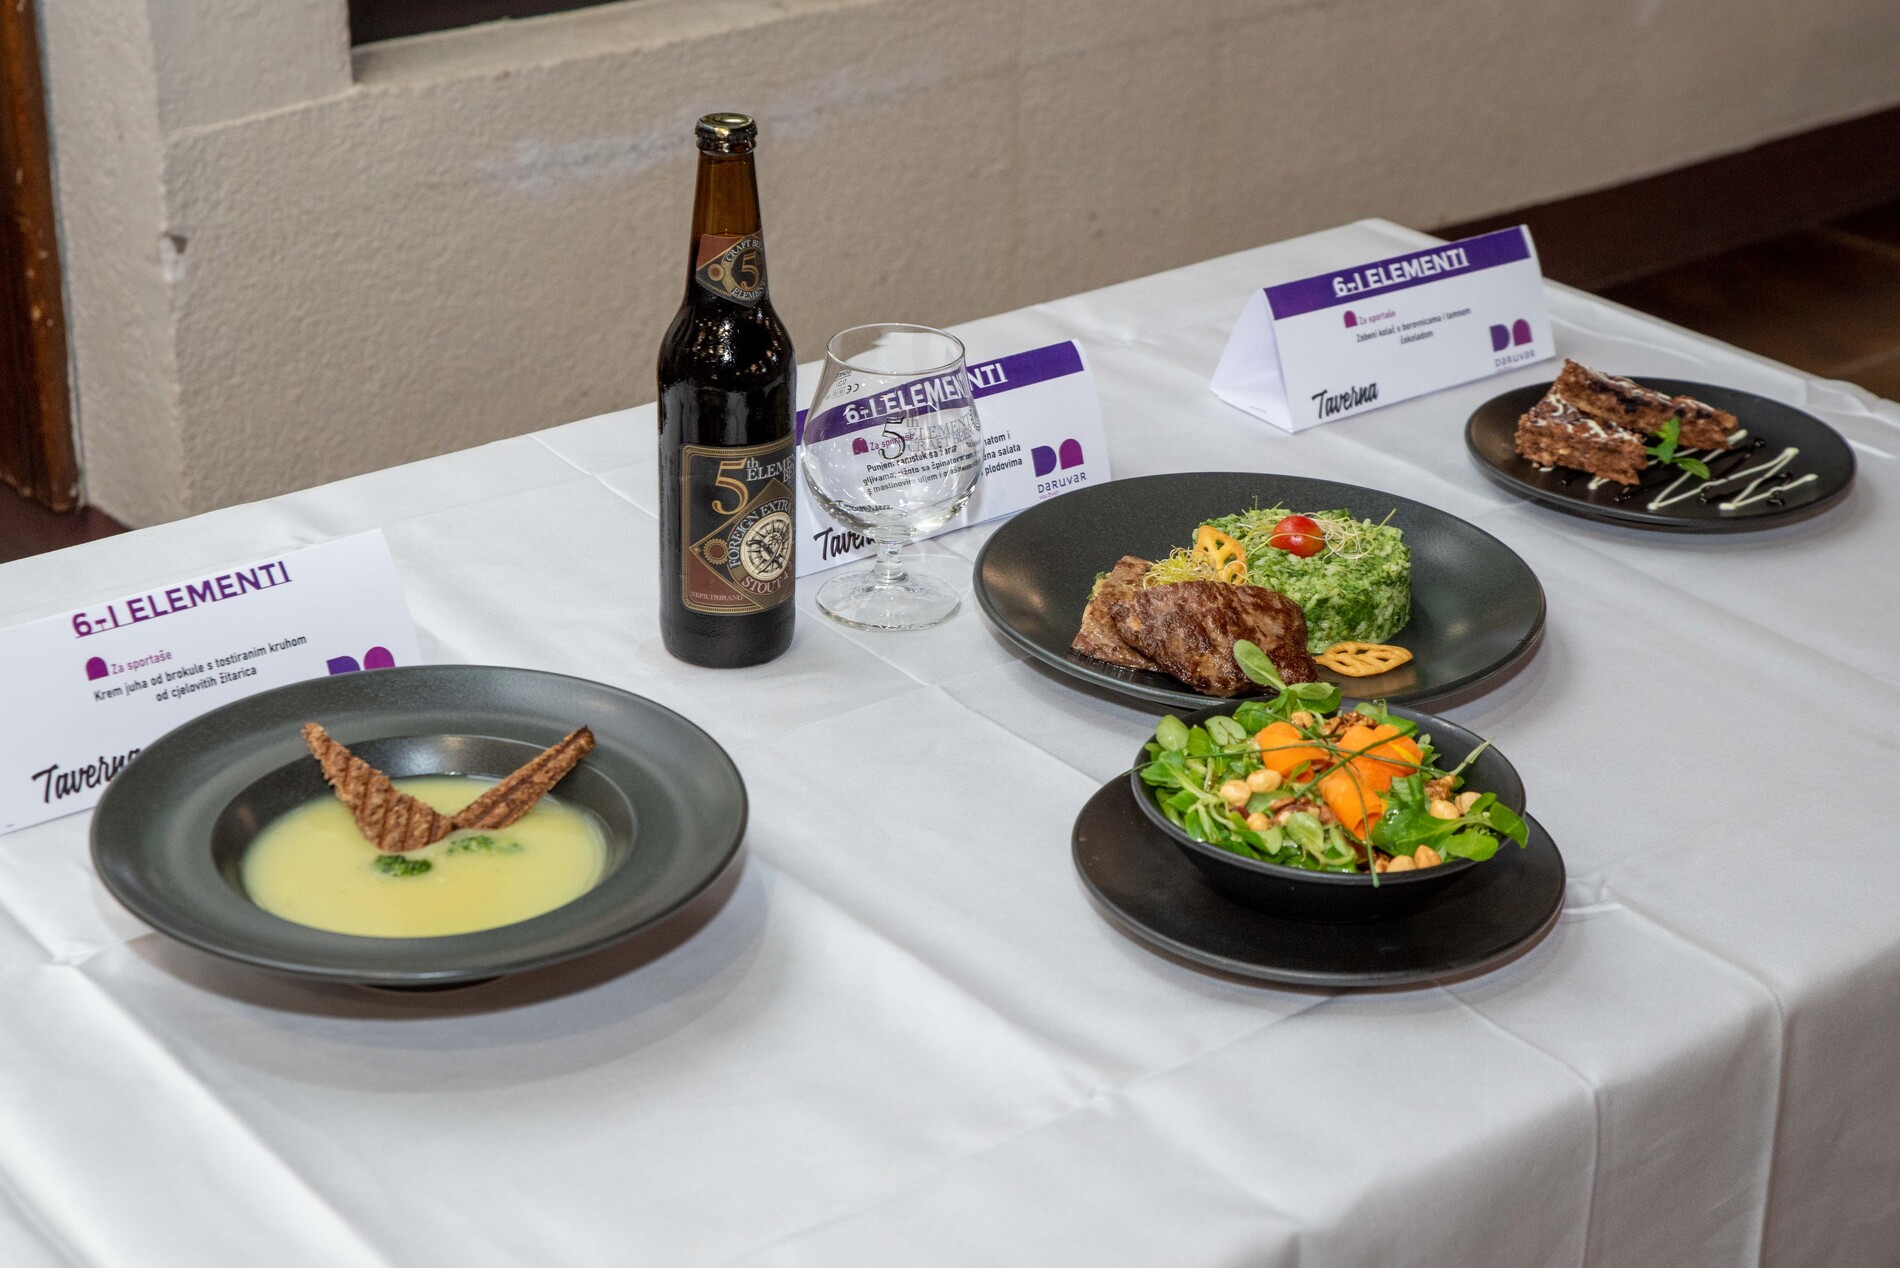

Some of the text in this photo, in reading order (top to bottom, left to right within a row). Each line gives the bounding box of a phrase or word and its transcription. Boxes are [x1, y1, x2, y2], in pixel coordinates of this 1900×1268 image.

[726, 240, 751, 261] CRAFT
[741, 250, 759, 292] 5
[1332, 247, 1470, 298] 6-I ELEMENTI
[1312, 382, 1379, 419] Taverna
[878, 416, 905, 460] 5
[998, 444, 1021, 457] salata
[747, 457, 759, 469] th
[985, 458, 1023, 477] plodovima
[712, 457, 749, 515] 5
[728, 512, 759, 568] FOREIGN
[71, 560, 293, 638] 6-I ELEMENTI
[690, 589, 744, 601] NEFILTRIRANO
[742, 576, 781, 594] STOUT
[94, 687, 123, 701] Krem
[125, 680, 148, 696] juha
[150, 673, 163, 686] od
[165, 663, 204, 682] brokule
[215, 646, 267, 668] tostiranim
[268, 635, 307, 653] kruhom
[111, 649, 172, 675] Za sportaše
[156, 666, 257, 701] od cjelovitih žitarica
